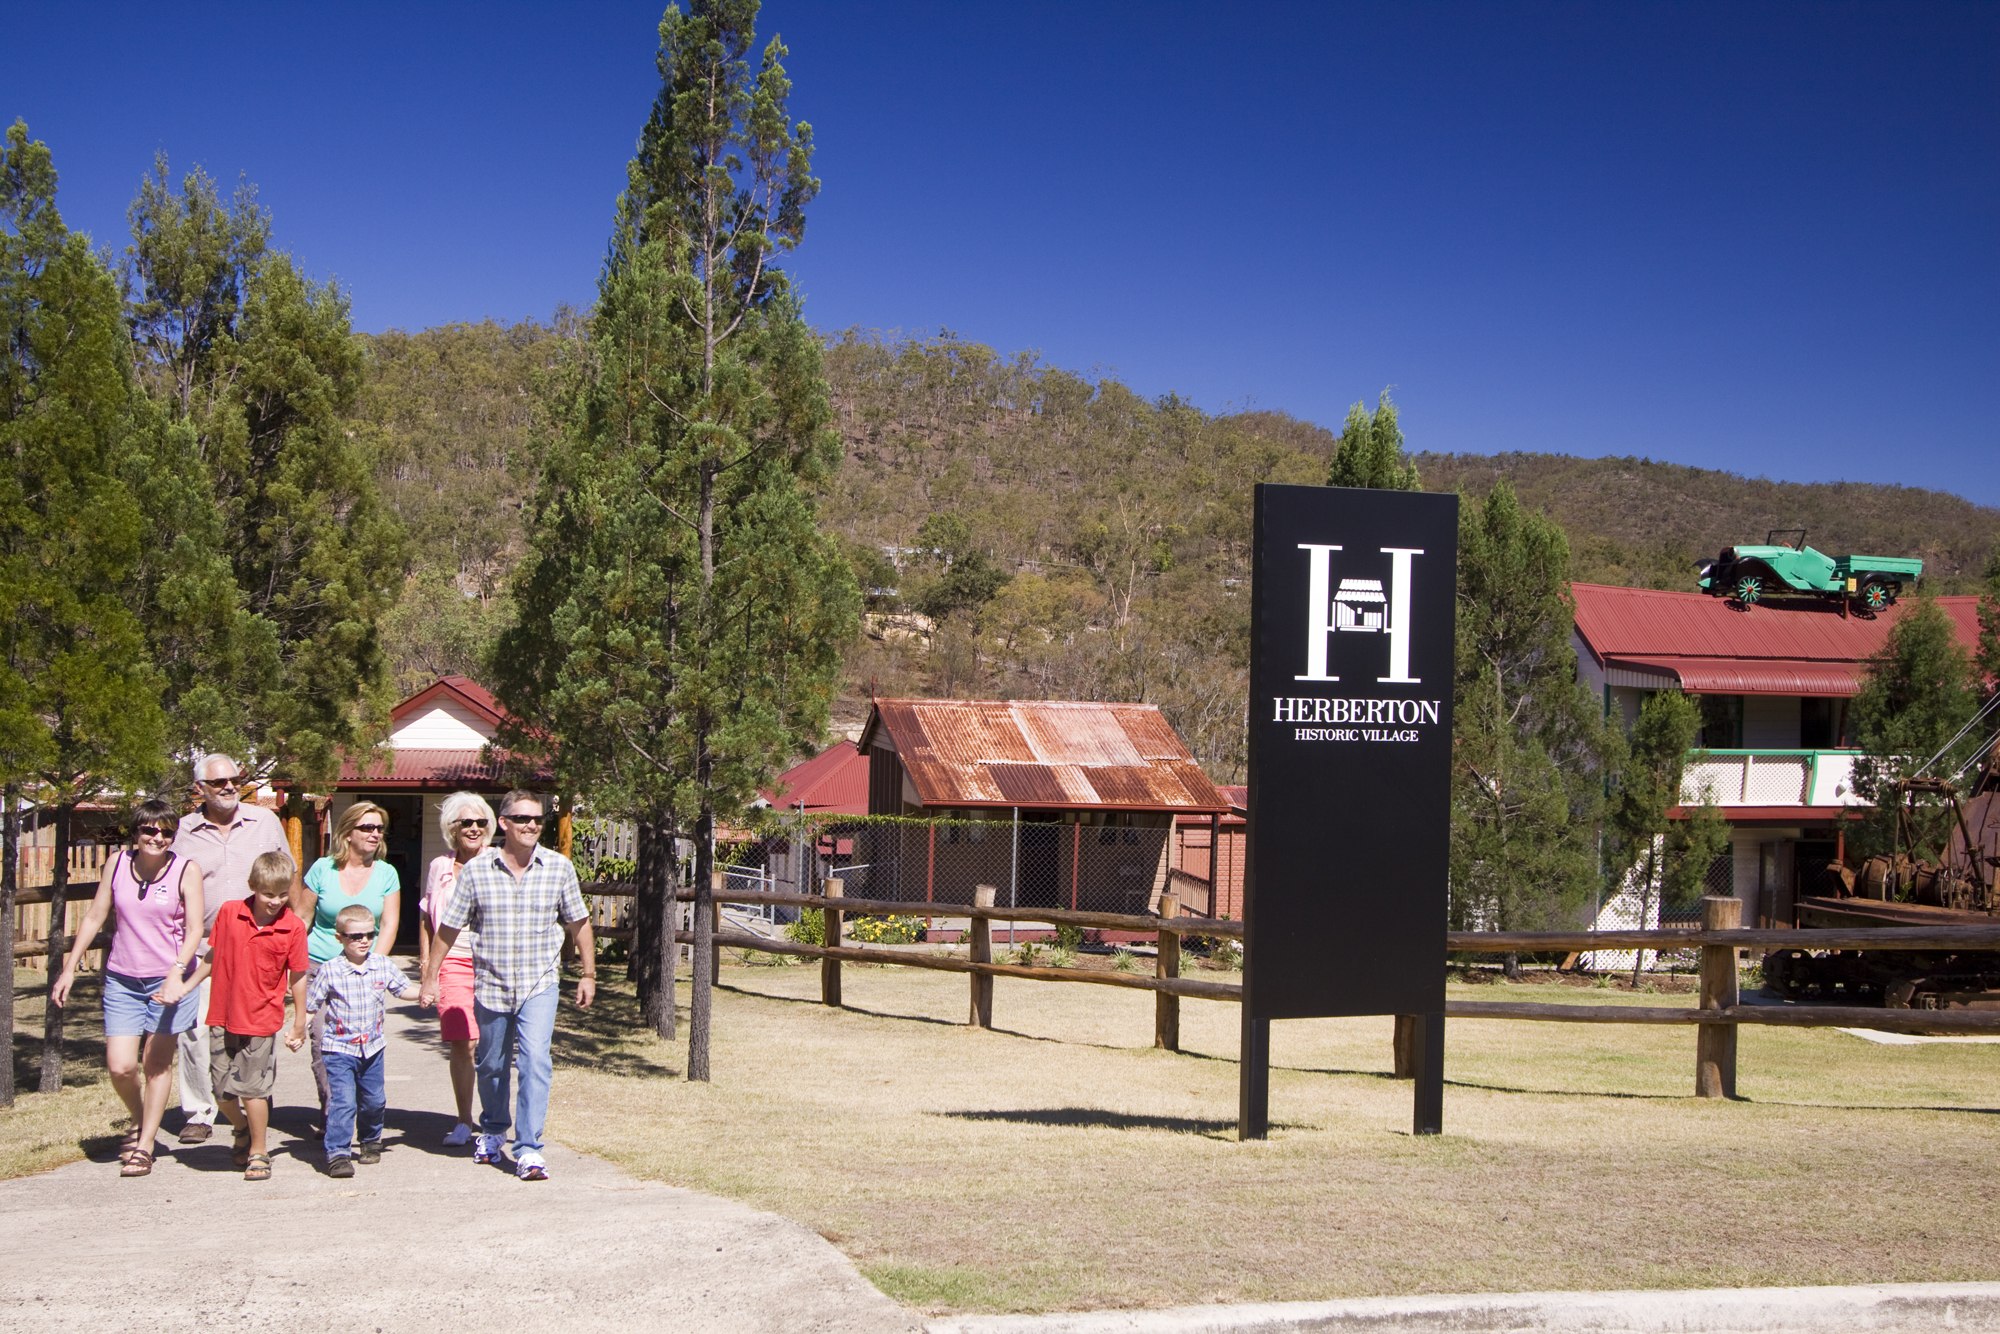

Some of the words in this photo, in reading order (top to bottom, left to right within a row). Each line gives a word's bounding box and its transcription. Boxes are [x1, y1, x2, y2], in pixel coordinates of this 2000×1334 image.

[1294, 543, 1425, 684] H
[1272, 697, 1441, 725] HERBERTON
[1294, 728, 1359, 741] HISTORIC
[1361, 729, 1419, 742] VILLAGE
